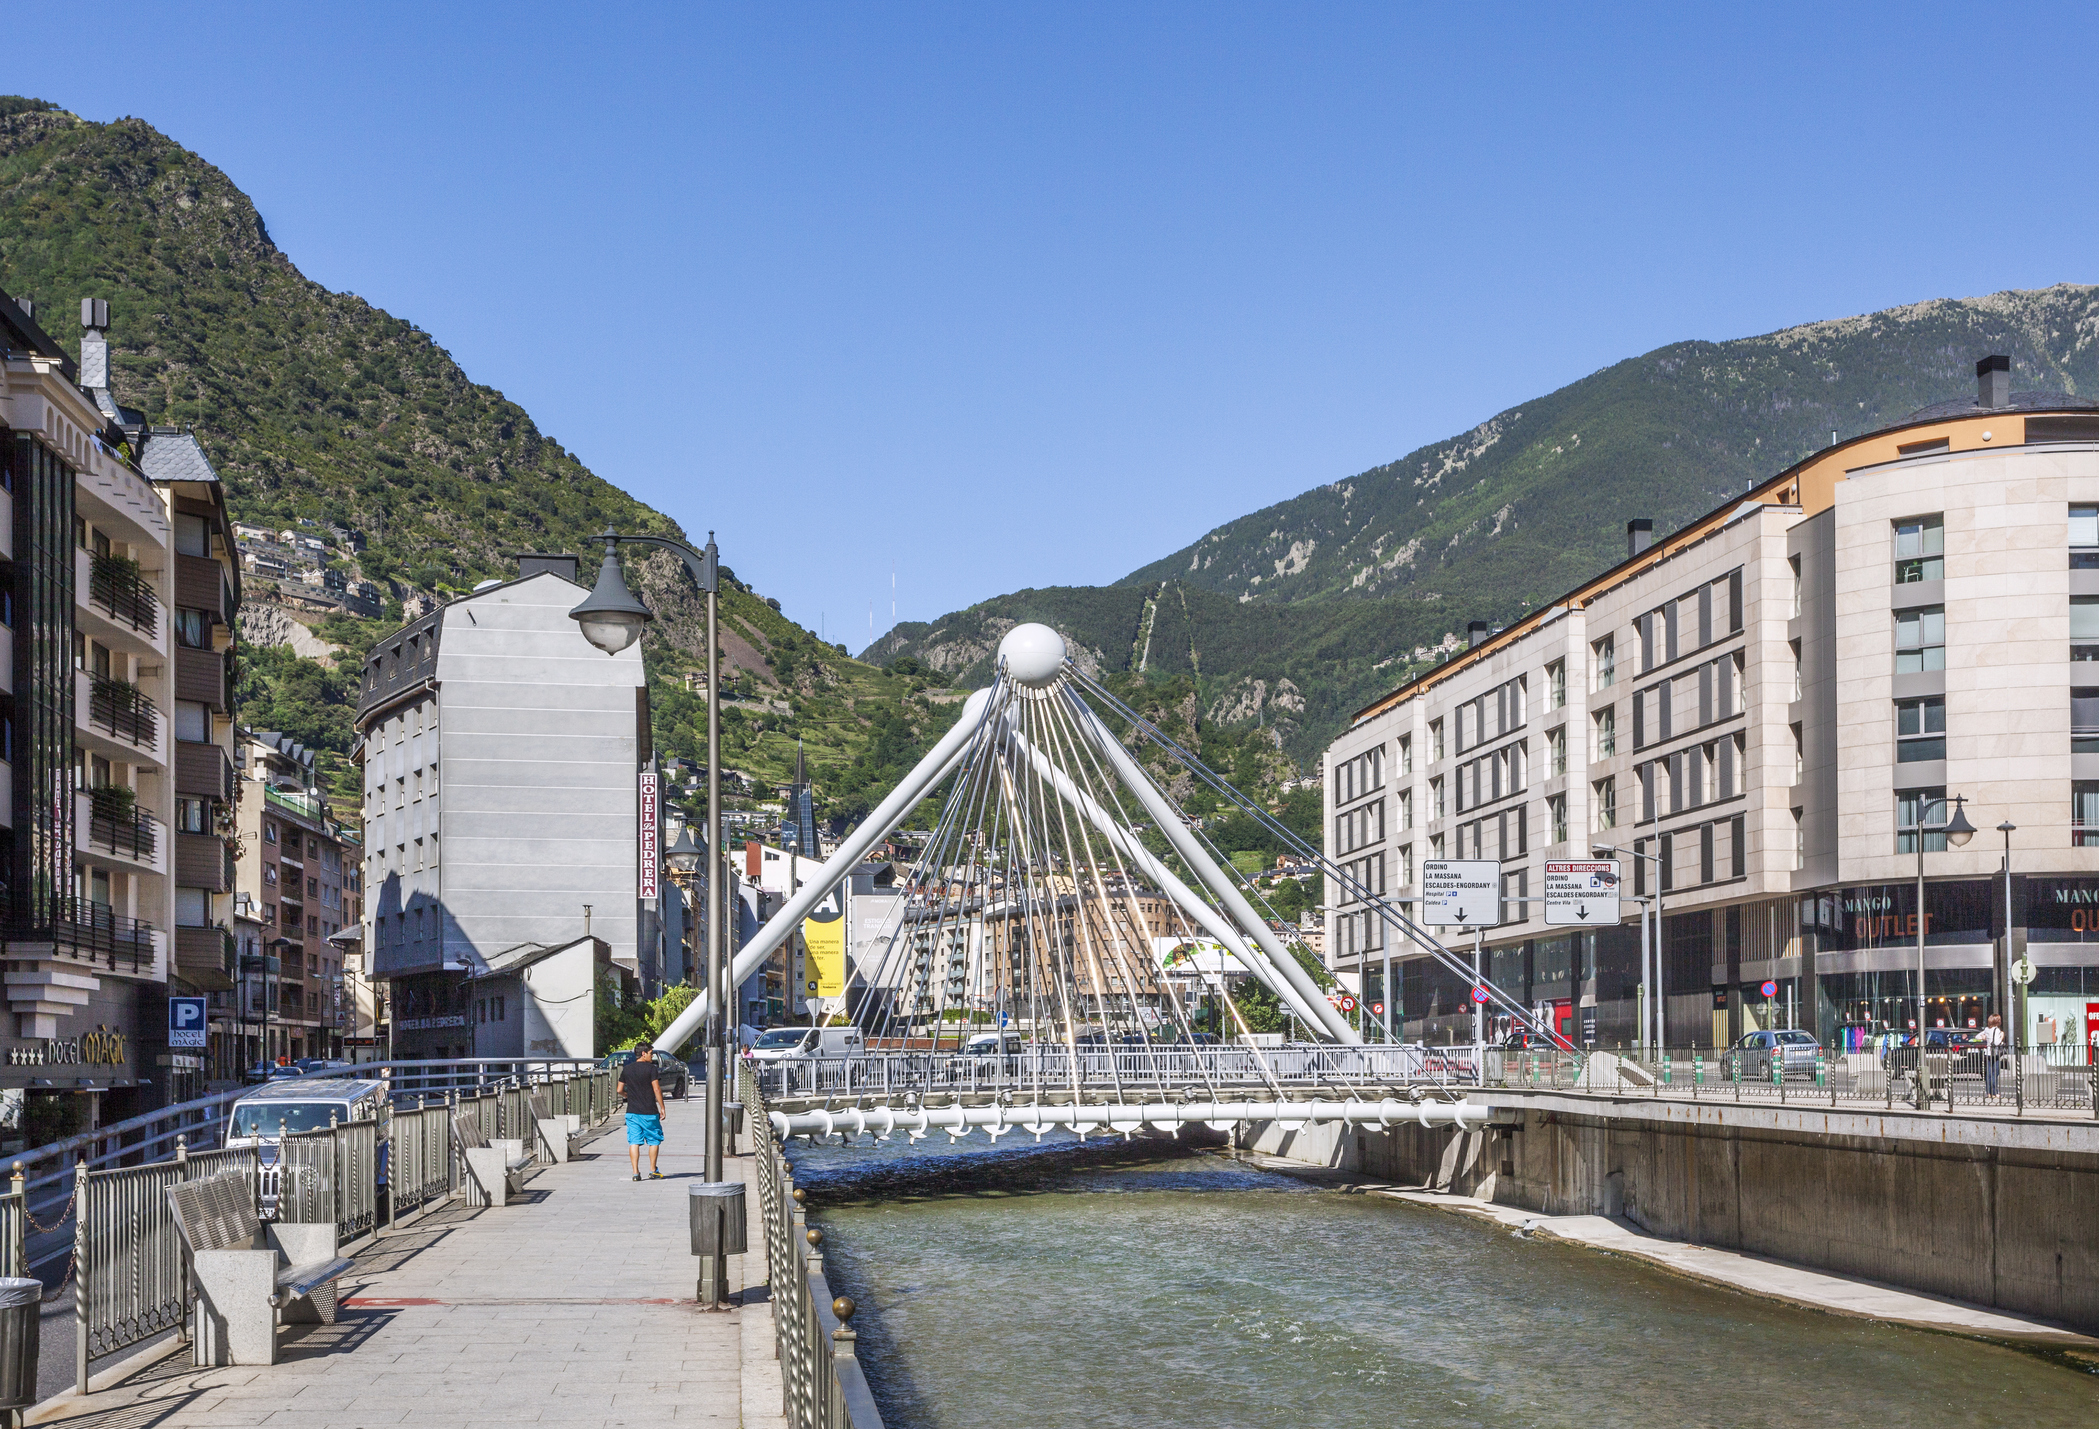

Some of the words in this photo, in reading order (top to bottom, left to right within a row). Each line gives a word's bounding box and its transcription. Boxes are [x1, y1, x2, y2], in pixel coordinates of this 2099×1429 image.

[643, 776, 655, 822] HOTEL
[643, 823, 655, 831] La
[643, 832, 655, 896] PEDRERA
[1845, 896, 1891, 912] MANGO
[1856, 912, 1933, 938] OUTLET
[177, 1003, 199, 1027] P
